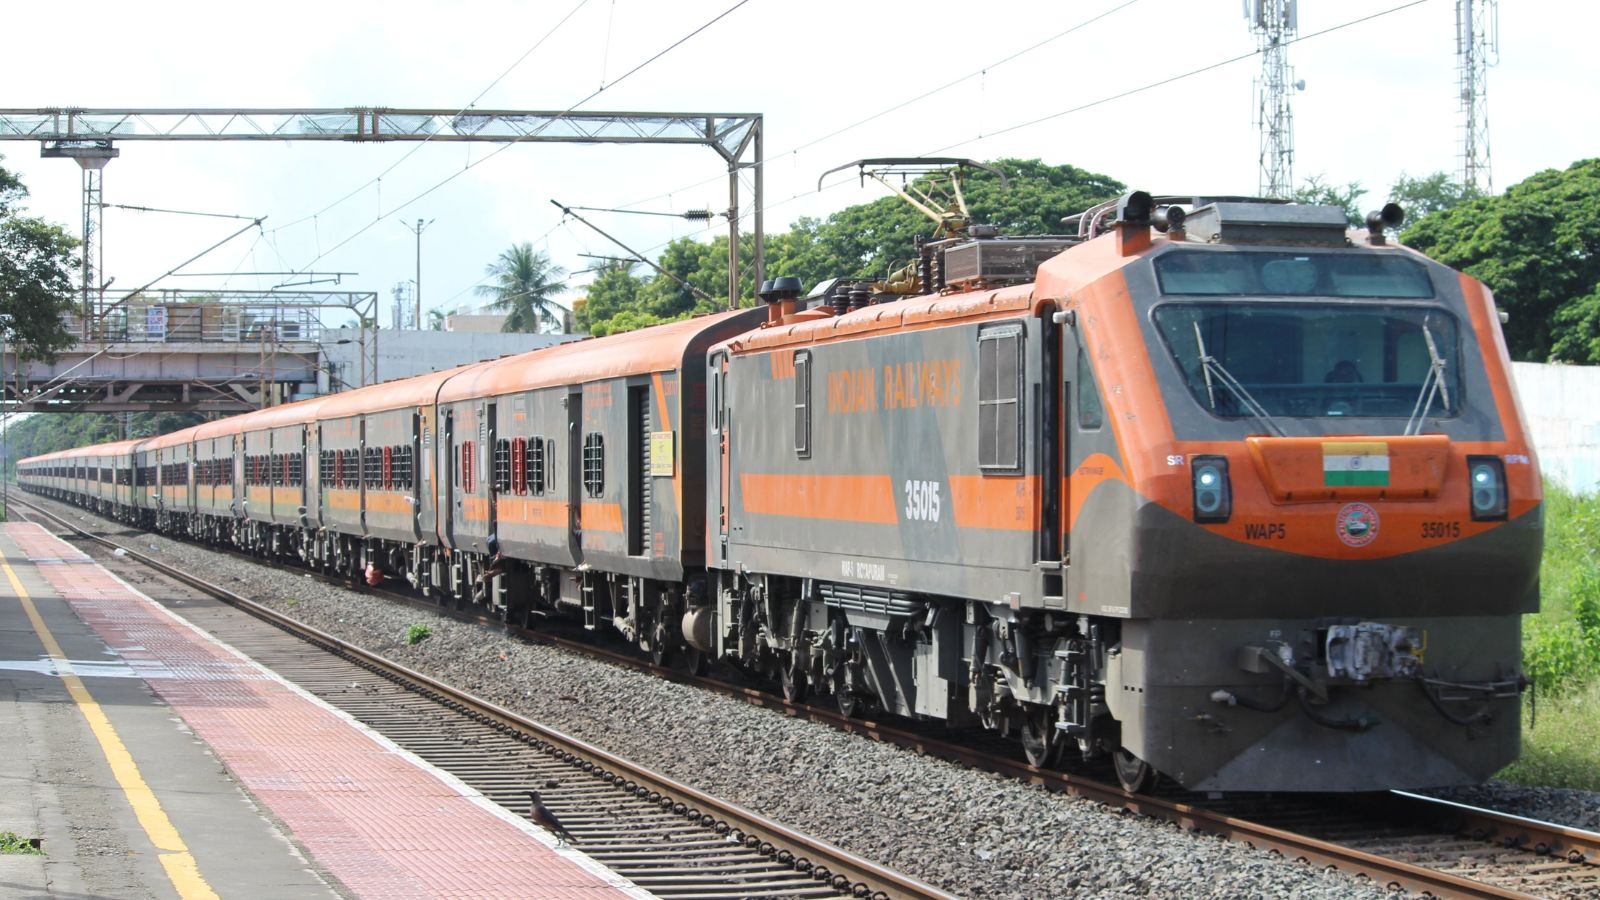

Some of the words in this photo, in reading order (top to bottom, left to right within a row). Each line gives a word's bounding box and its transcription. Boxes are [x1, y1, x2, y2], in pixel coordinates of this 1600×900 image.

[828, 367, 876, 414] INDIAN
[883, 358, 961, 411] RAILWAYS
[1166, 455, 1184, 466] SR
[904, 479, 941, 523] 35015
[1245, 523, 1286, 540] WAP5
[1421, 522, 1461, 539] 35015
